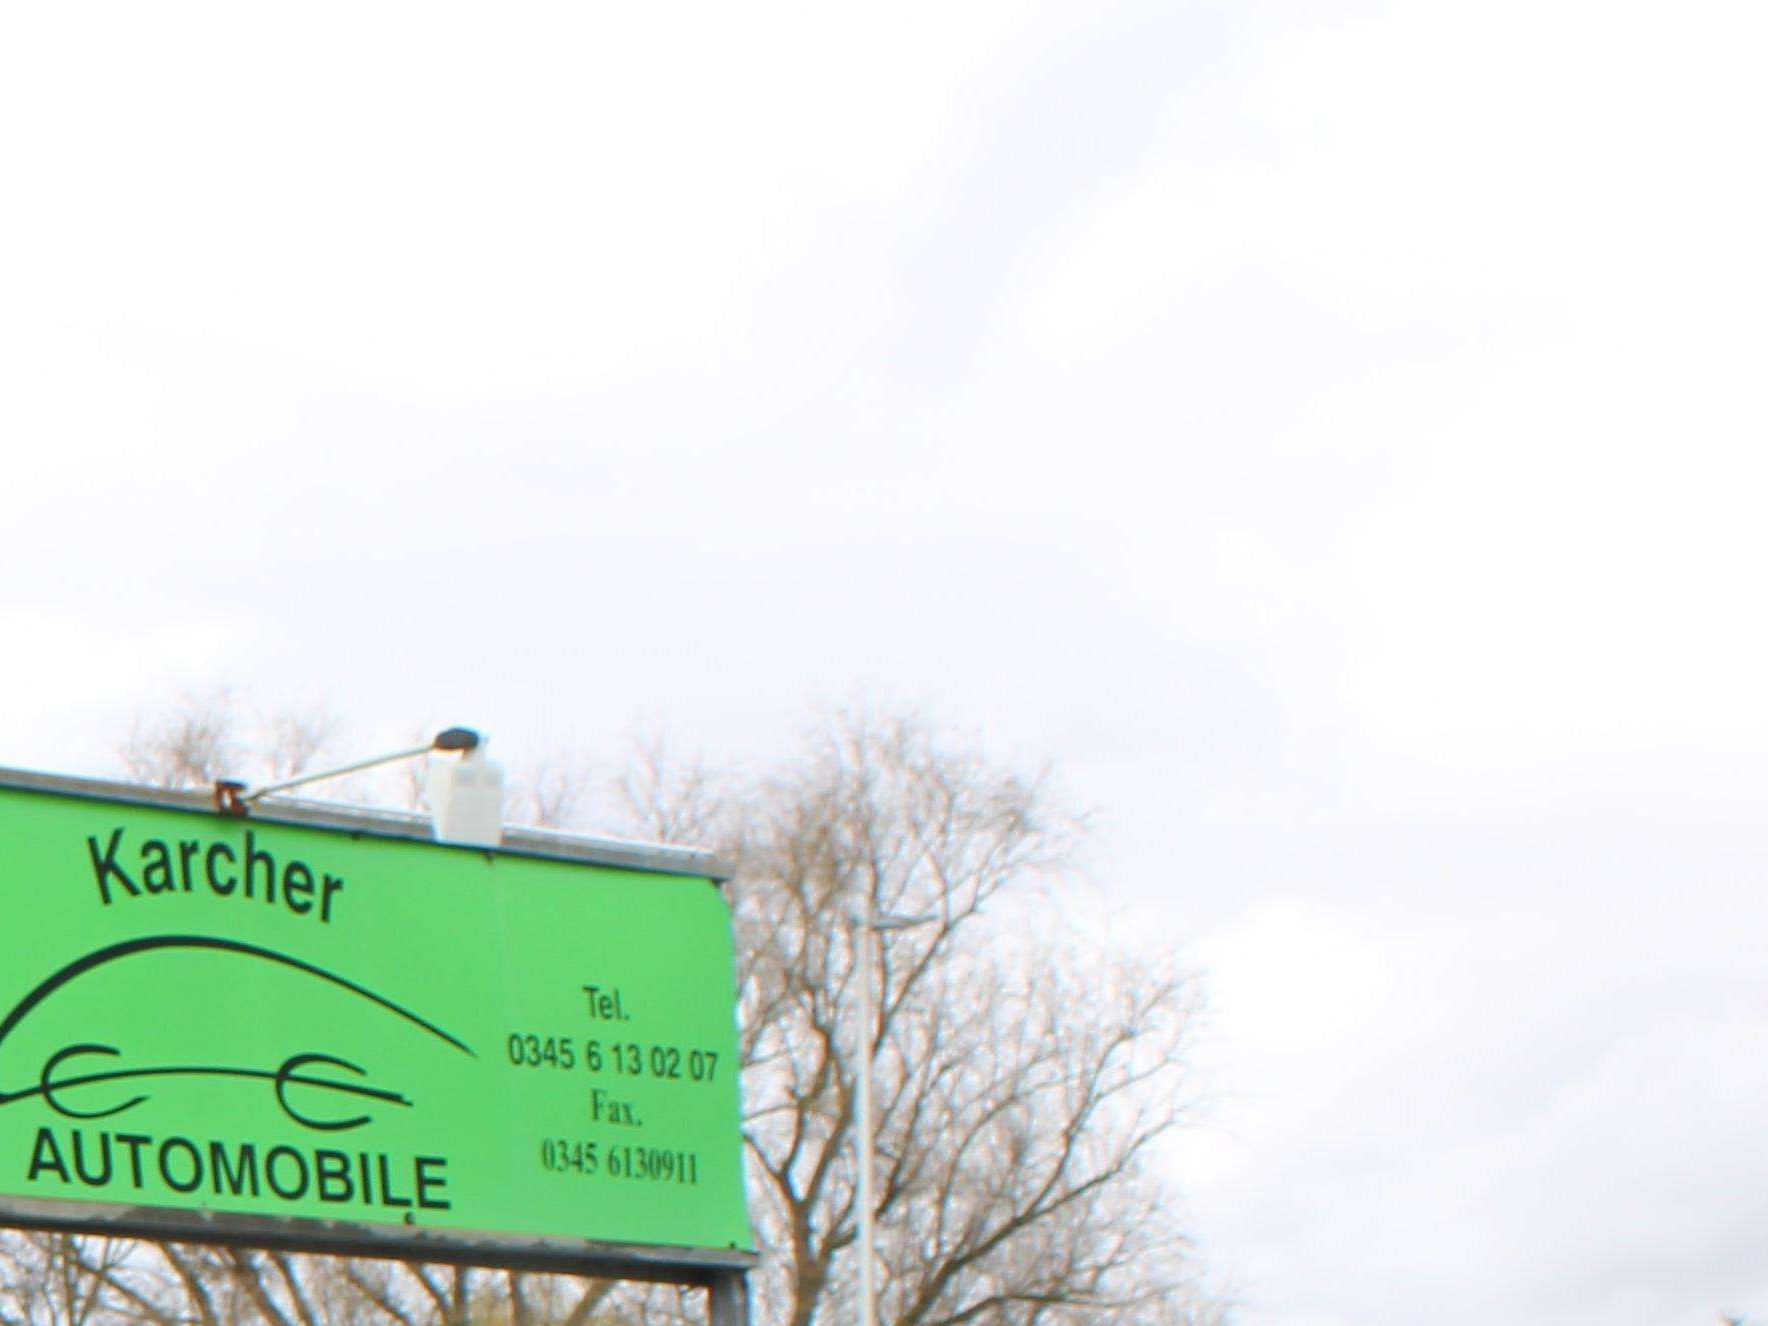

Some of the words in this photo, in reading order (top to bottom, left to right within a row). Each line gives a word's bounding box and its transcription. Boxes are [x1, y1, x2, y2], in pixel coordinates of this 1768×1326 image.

[86, 826, 344, 924] Karcher
[581, 984, 630, 1022] Tel.
[507, 1032, 575, 1071] 0345
[586, 1040, 603, 1073] 6
[611, 1043, 643, 1076] 13
[650, 1046, 682, 1080] 02
[688, 1049, 719, 1082] 07
[591, 1088, 643, 1127] Fax.
[26, 1126, 453, 1211] AUTOMOBILE
[541, 1137, 598, 1175] 0345
[607, 1146, 698, 1185] 6130911
